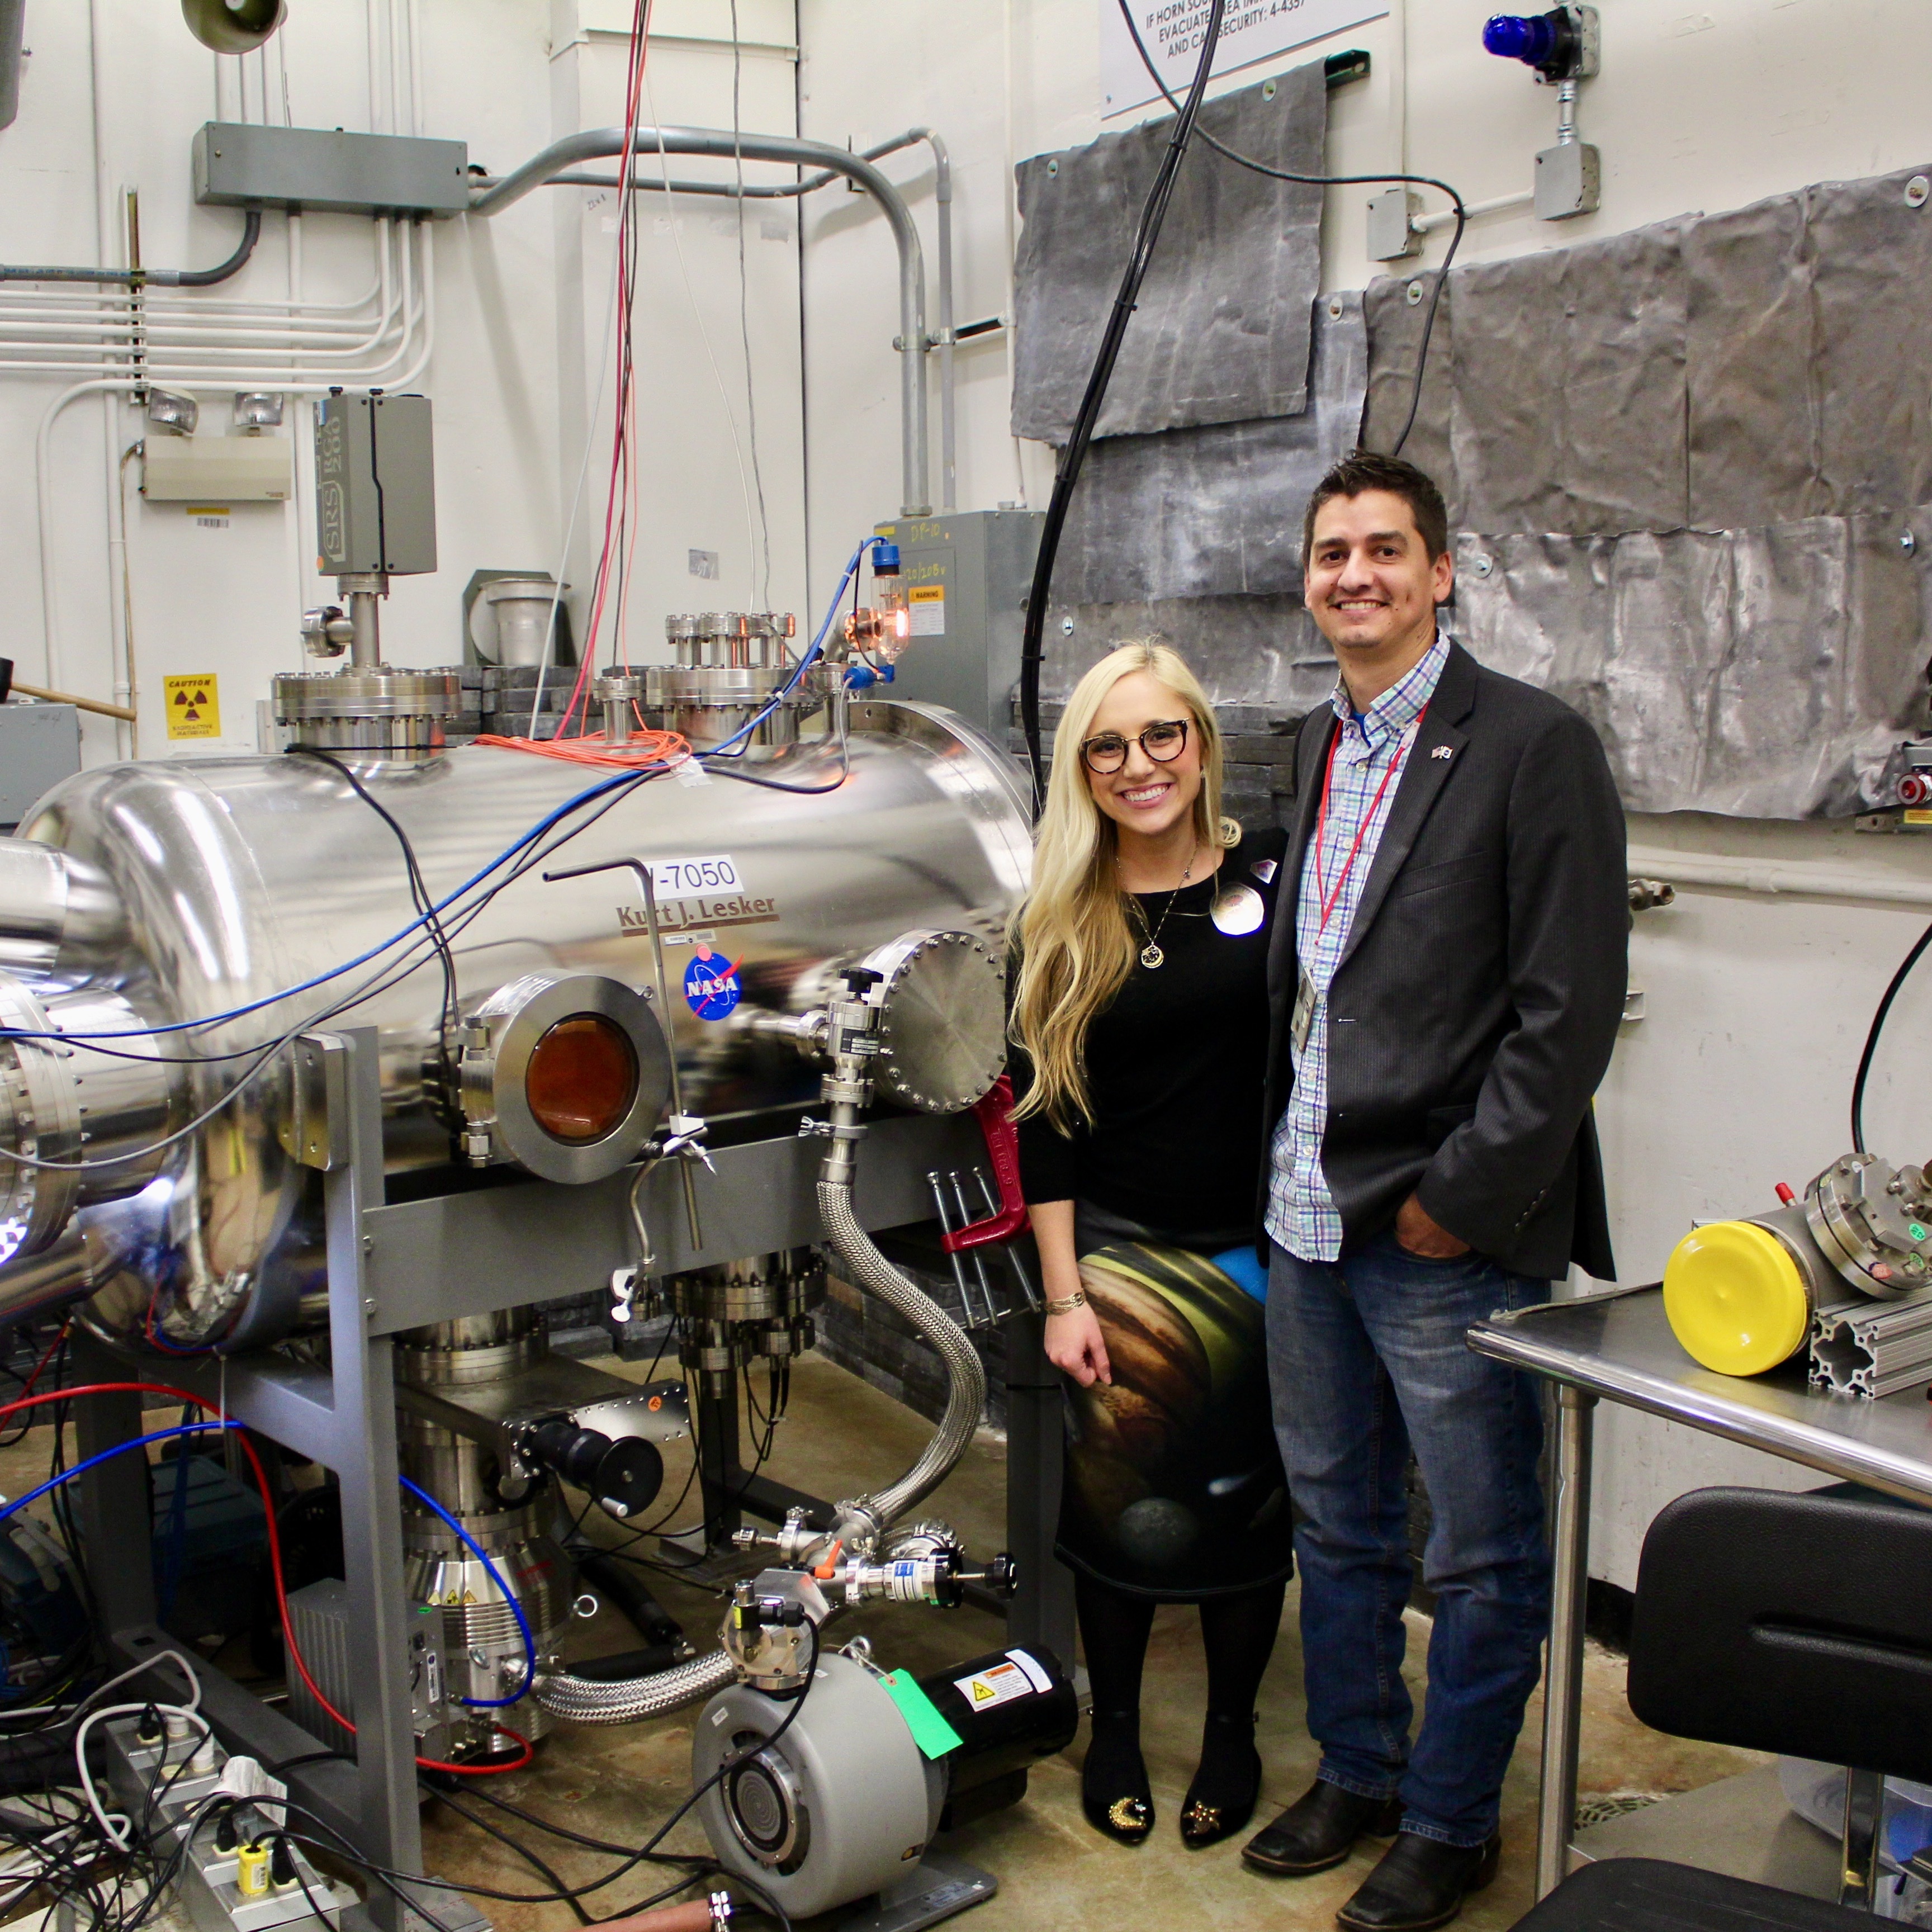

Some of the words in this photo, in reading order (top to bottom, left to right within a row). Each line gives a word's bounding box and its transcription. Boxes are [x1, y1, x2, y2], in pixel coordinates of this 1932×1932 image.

[1146, 12, 1154, 29] IF
[1157, 2, 1185, 25] HORN
[1159, 9, 1210, 43] EVACUATE
[1167, 37, 1188, 59] AND
[1191, 30, 1207, 49] CA
[1218, 7, 1267, 39] SECURITY:
[326, 487, 339, 550] SRS
[916, 590, 939, 599] WARNING
[169, 679, 211, 688] CAUTION
[677, 901, 694, 930] J.
[698, 896, 775, 919] Lesker
[686, 977, 738, 997] NASA
